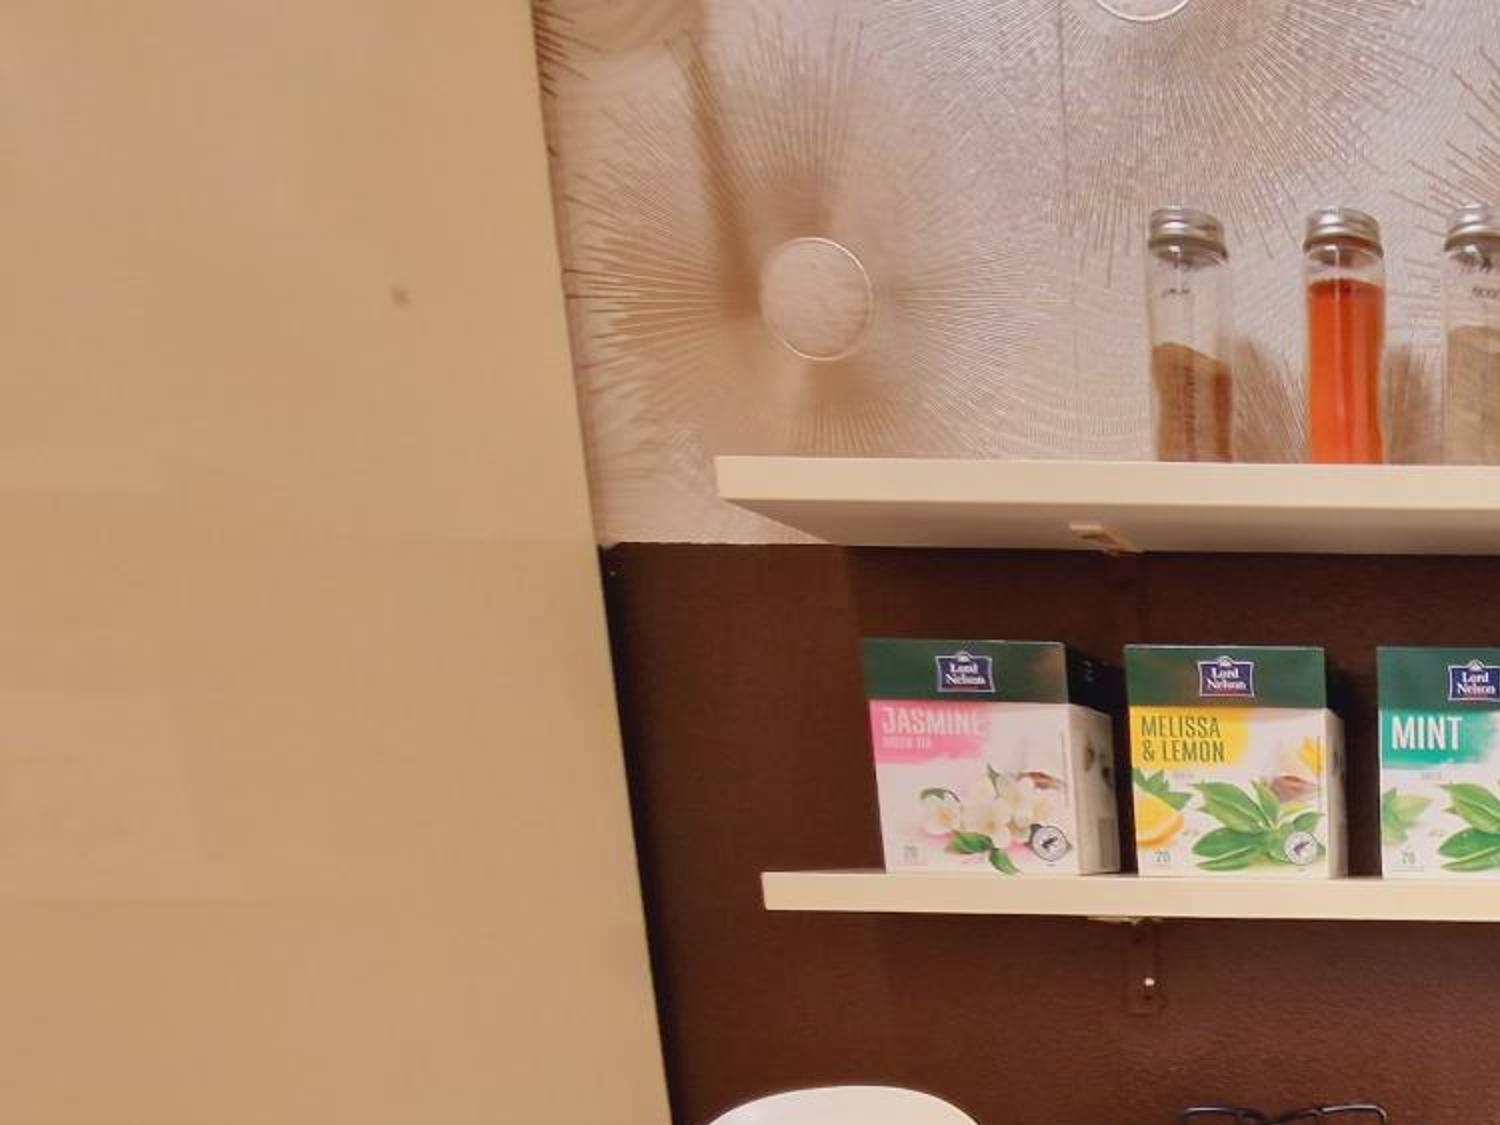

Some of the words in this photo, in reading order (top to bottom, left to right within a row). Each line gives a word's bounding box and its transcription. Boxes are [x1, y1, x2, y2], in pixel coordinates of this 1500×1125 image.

[949, 661, 979, 674] Lord
[1211, 666, 1240, 679] Lord
[1461, 671, 1489, 683] Lord
[1206, 678, 1248, 691] Nelson
[1456, 682, 1497, 695] Nelson
[881, 707, 984, 736] JASMINE
[1141, 716, 1222, 739] MELISSA
[1391, 716, 1463, 750] MINT
[1143, 740, 1155, 762] &
[1162, 741, 1226, 763] LEMON
